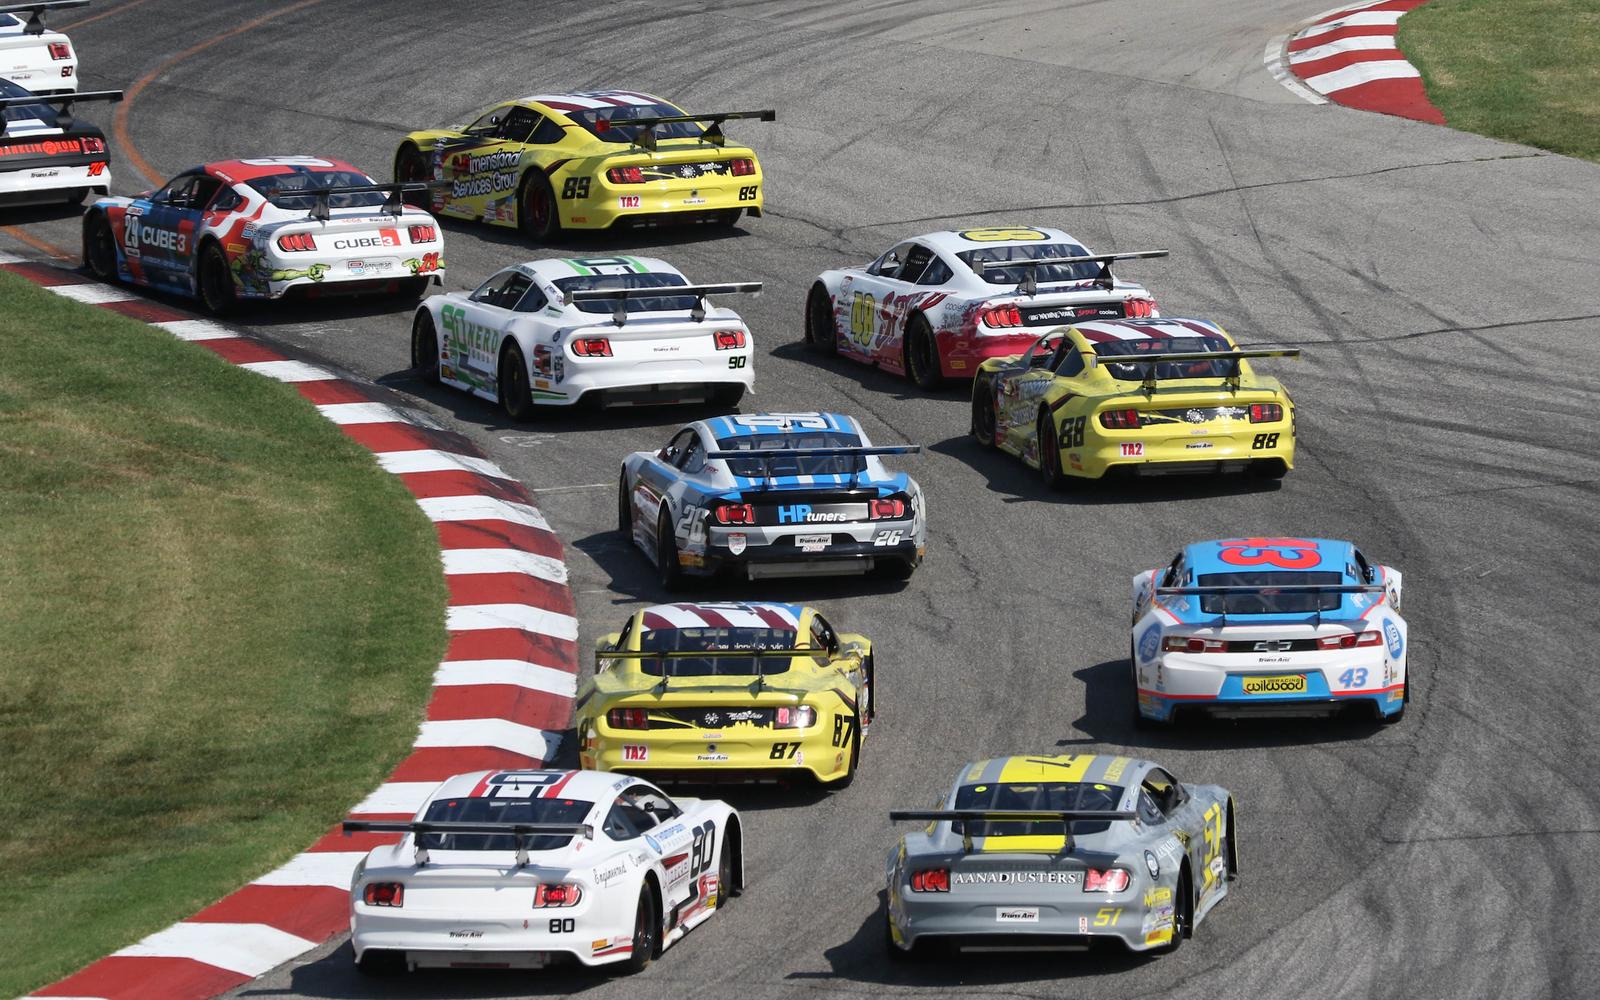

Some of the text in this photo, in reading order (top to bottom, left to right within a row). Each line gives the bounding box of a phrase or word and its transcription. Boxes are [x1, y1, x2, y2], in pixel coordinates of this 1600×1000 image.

[452, 177, 492, 199] Services
[562, 176, 592, 200] 89
[739, 186, 758, 201] 89
[621, 196, 640, 208] TA2
[124, 214, 139, 248] 29
[142, 226, 187, 252] CUBE3
[334, 236, 394, 250] CUBE3
[418, 251, 440, 273] 29
[850, 290, 875, 347] 48
[728, 356, 747, 370] 90
[1059, 415, 1087, 449] 88
[1252, 433, 1281, 449] 88
[1121, 442, 1144, 456] TA2
[675, 503, 707, 543] 26
[778, 504, 847, 524] HP tuners
[874, 530, 905, 547] 26
[1246, 678, 1304, 692] wilwood
[1338, 667, 1369, 689] 43
[832, 713, 855, 749] 87
[624, 745, 647, 760] TA2
[769, 741, 802, 760] 87
[690, 819, 716, 879] 80
[549, 918, 575, 934] 80
[1093, 908, 1122, 927] 51
